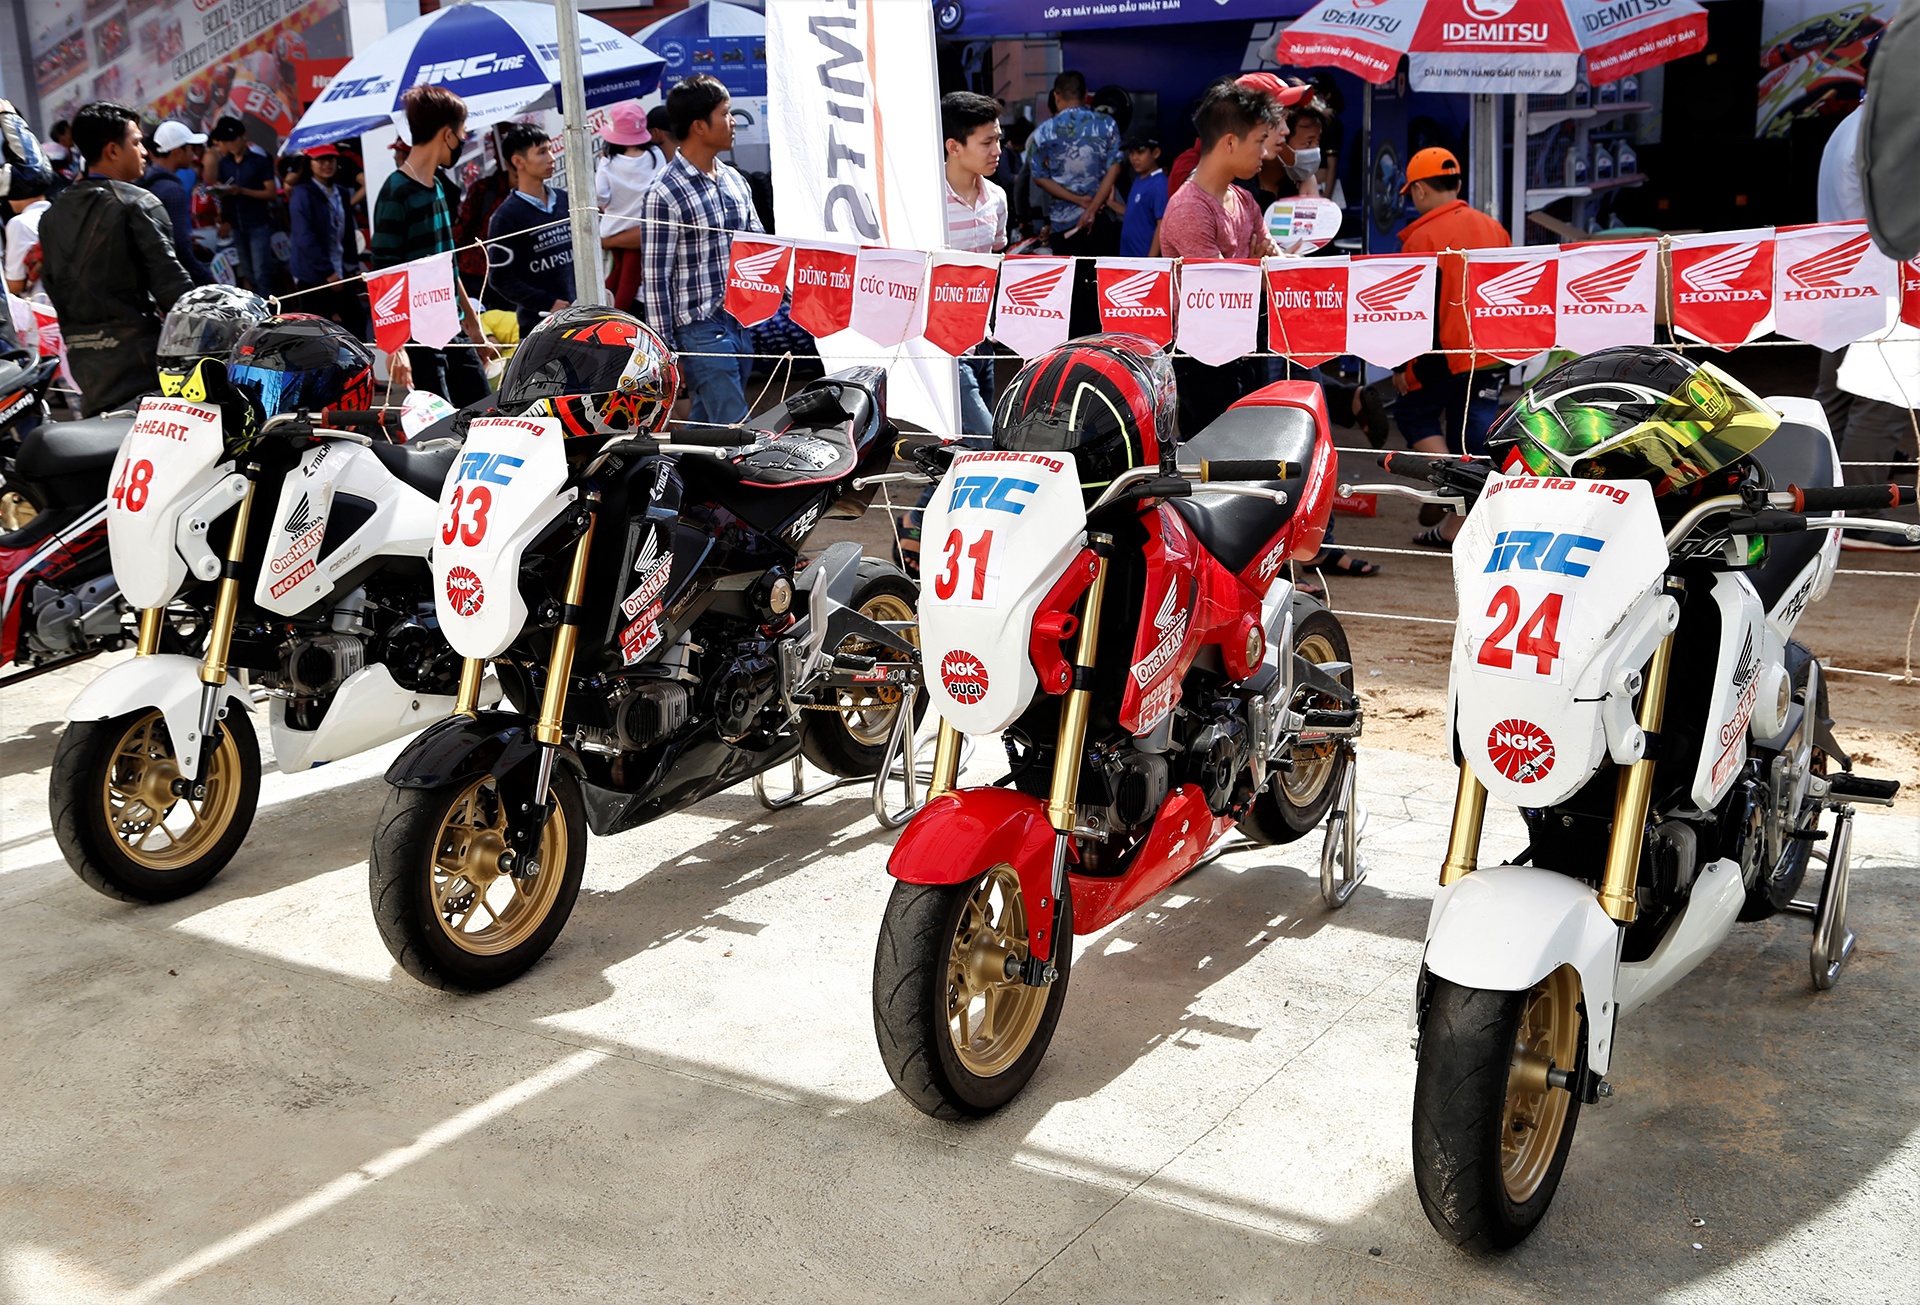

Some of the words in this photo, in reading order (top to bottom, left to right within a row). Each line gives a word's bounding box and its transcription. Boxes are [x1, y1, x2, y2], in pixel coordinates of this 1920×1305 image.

[1321, 9, 1402, 33] IDEMITSU
[1582, 0, 1670, 32] IDEMITSU
[1443, 23, 1548, 42] IDEMITSU
[491, 54, 526, 71] TIRE
[730, 278, 781, 295] HONDA
[798, 265, 828, 287] DŨNG
[429, 287, 451, 304] VINH
[860, 273, 885, 296] CÚC
[887, 281, 918, 302] VINH
[934, 282, 963, 303] DŨNG
[966, 282, 991, 304] TIẾN
[1274, 286, 1312, 309] DŨNG
[1313, 282, 1344, 309] TIẾN
[1679, 288, 1767, 305] HONDA
[1783, 284, 1880, 302] HONDA
[1186, 288, 1216, 310] CÚC
[1219, 292, 1254, 310] VINH
[1562, 302, 1648, 316] HONDA
[375, 312, 410, 327] HONDA
[1000, 304, 1066, 321] HONDA
[1104, 306, 1168, 319] HONDA
[1352, 310, 1429, 324] HONDA
[1474, 303, 1554, 318] HONDA
[138, 401, 157, 412] nda
[158, 402, 217, 423] Racing
[490, 418, 546, 437] Racing
[310, 442, 332, 470] TAICHI
[112, 458, 154, 513] 48
[656, 464, 671, 493] TAICHI
[1332, 497, 1359, 509] HOND
[442, 485, 492, 547] 33
[290, 516, 324, 542] HONDA
[640, 550, 672, 582] HONDA
[935, 528, 994, 601] 31
[272, 560, 316, 598] MOTUL
[450, 577, 477, 591] NGK
[623, 603, 662, 643] MOTUL
[1157, 607, 1187, 641] HONDA
[1477, 585, 1564, 676] 24
[624, 625, 657, 661] RK
[945, 661, 979, 677] NGK
[1735, 657, 1761, 700] HONDA
[950, 682, 981, 696] BUGI
[1142, 674, 1174, 708] MOTUL
[1142, 693, 1168, 727] RK
[1496, 732, 1543, 752] NGK
